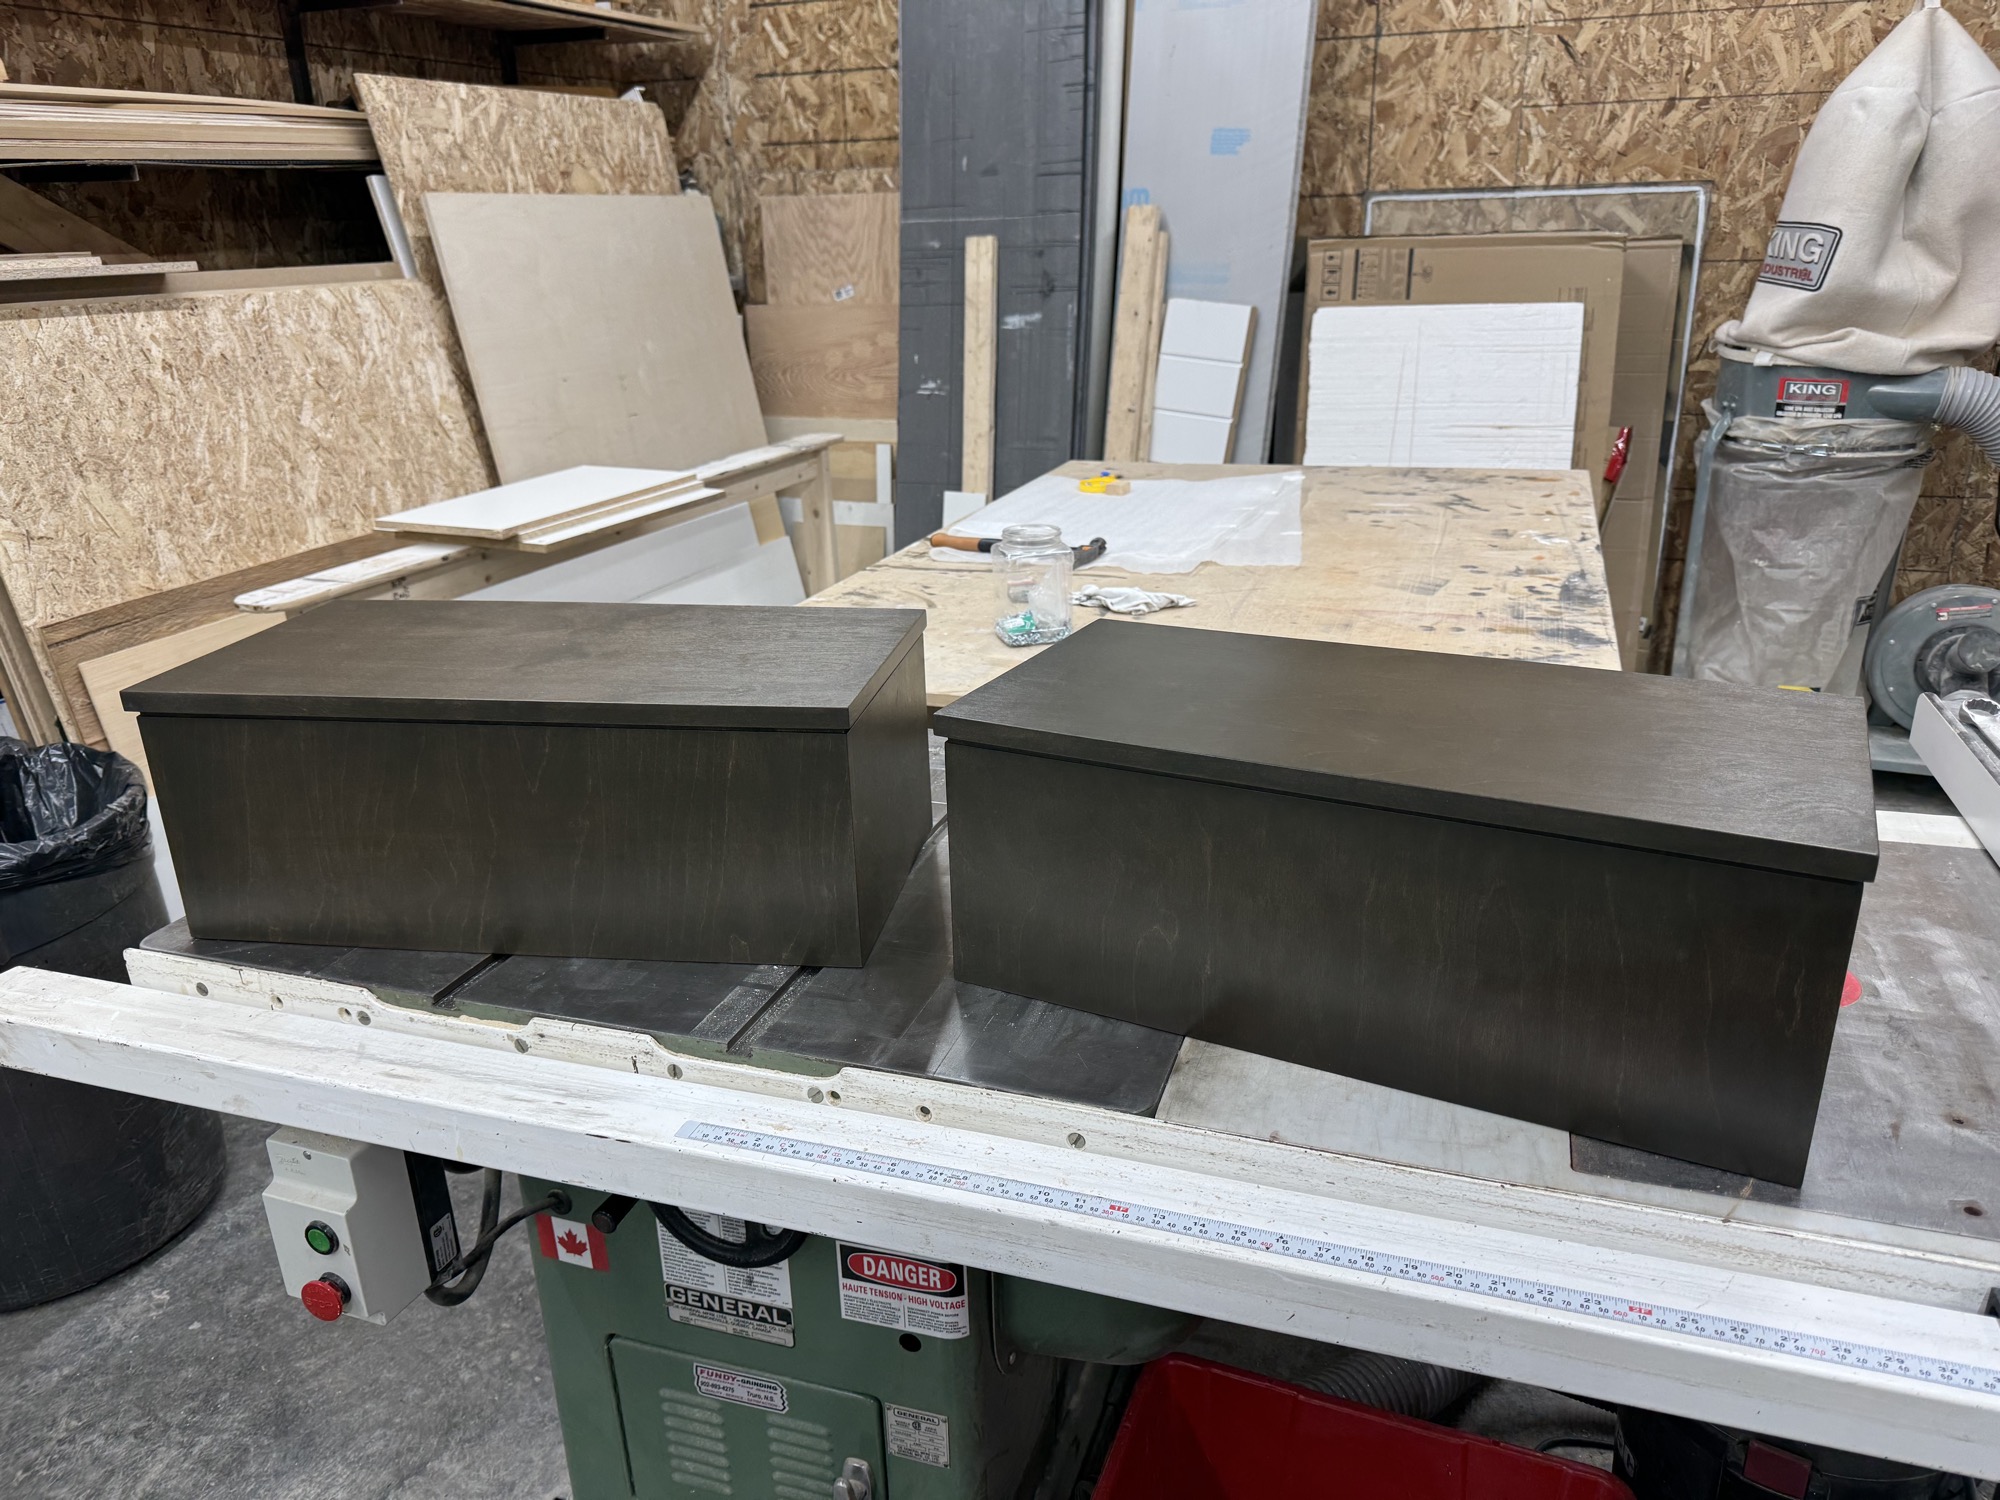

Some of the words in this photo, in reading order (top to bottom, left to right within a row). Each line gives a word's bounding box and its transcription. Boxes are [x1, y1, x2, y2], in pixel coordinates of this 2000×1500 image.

[1762, 264, 1813, 282] DUSTRIAL
[1788, 384, 1836, 395] KING
[863, 1256, 941, 1288] DANGER
[670, 1286, 787, 1326] GENERAL
[842, 1282, 868, 1294] HAUTE
[869, 1288, 902, 1301] TENSION
[908, 1296, 928, 1306] HIGH
[929, 1300, 966, 1310] VOLTAGE
[897, 1411, 936, 1423] GENERAL
